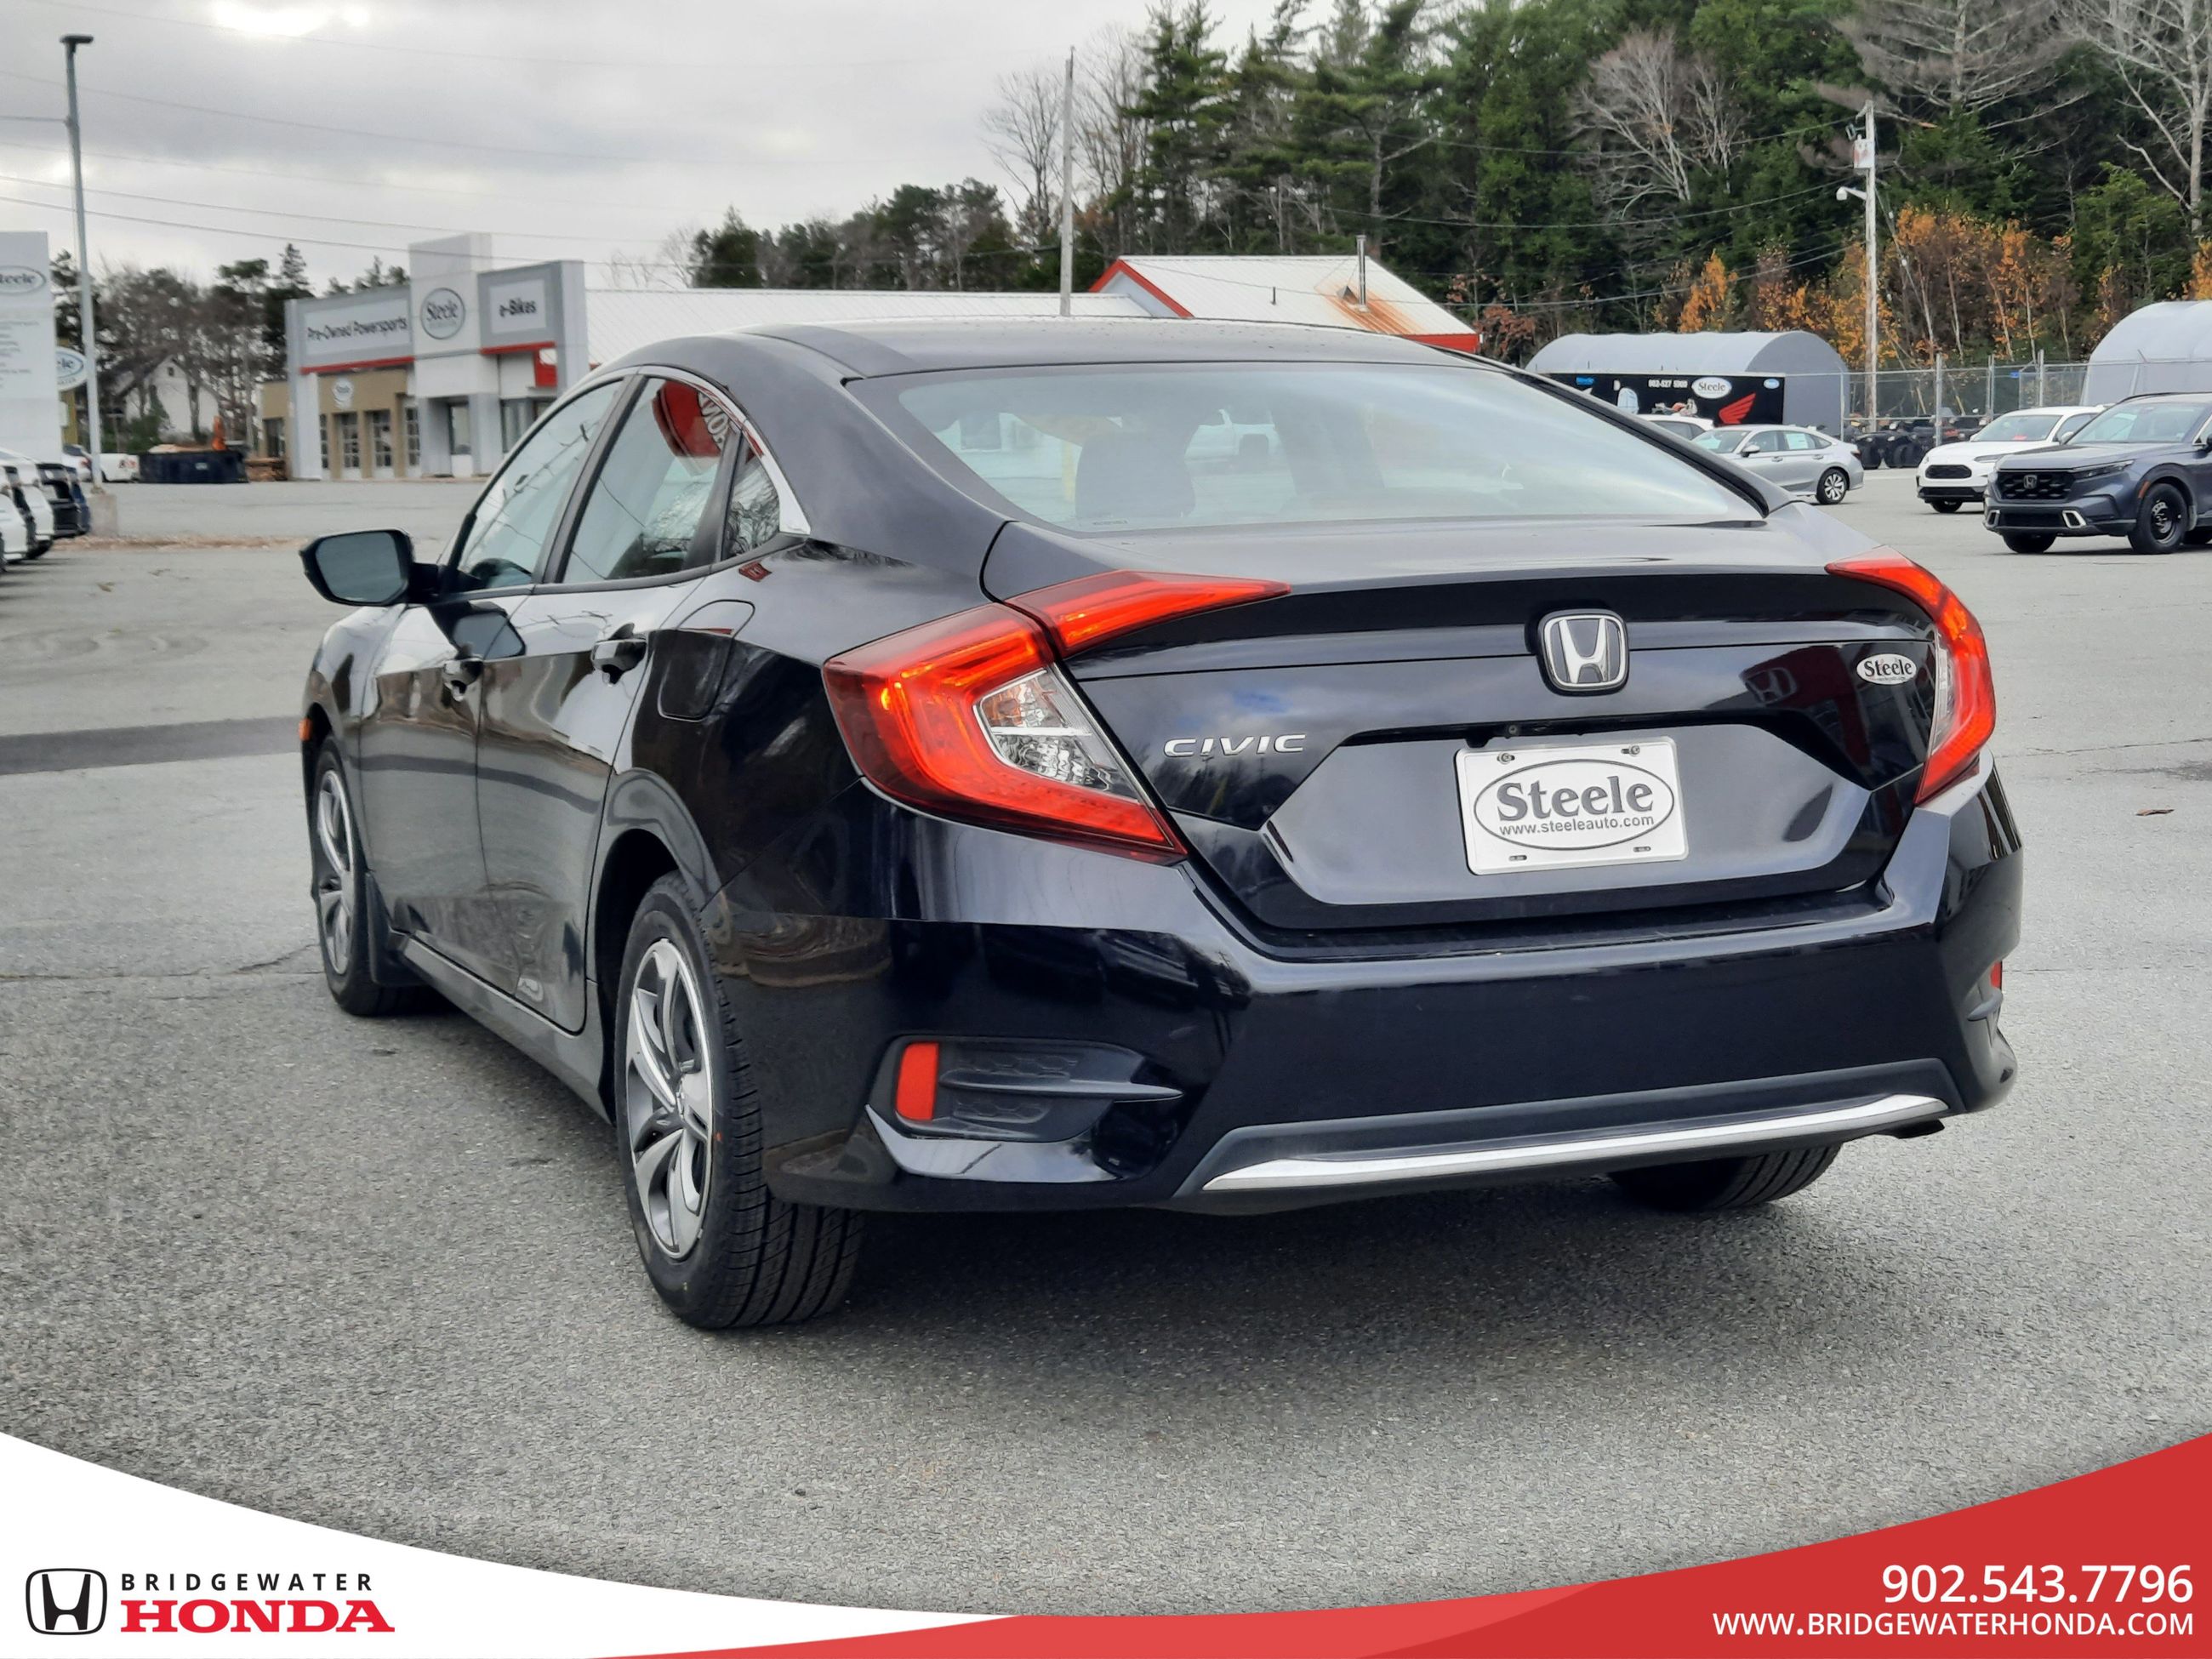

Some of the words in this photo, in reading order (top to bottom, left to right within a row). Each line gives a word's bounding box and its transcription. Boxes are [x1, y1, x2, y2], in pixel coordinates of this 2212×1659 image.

[1698, 382, 1726, 392] Steele
[1863, 659, 1913, 677] Steele
[1163, 733, 1307, 758] CIVIC
[1497, 775, 1654, 822] Steele
[1499, 815, 1655, 835] www.steeleauto.com
